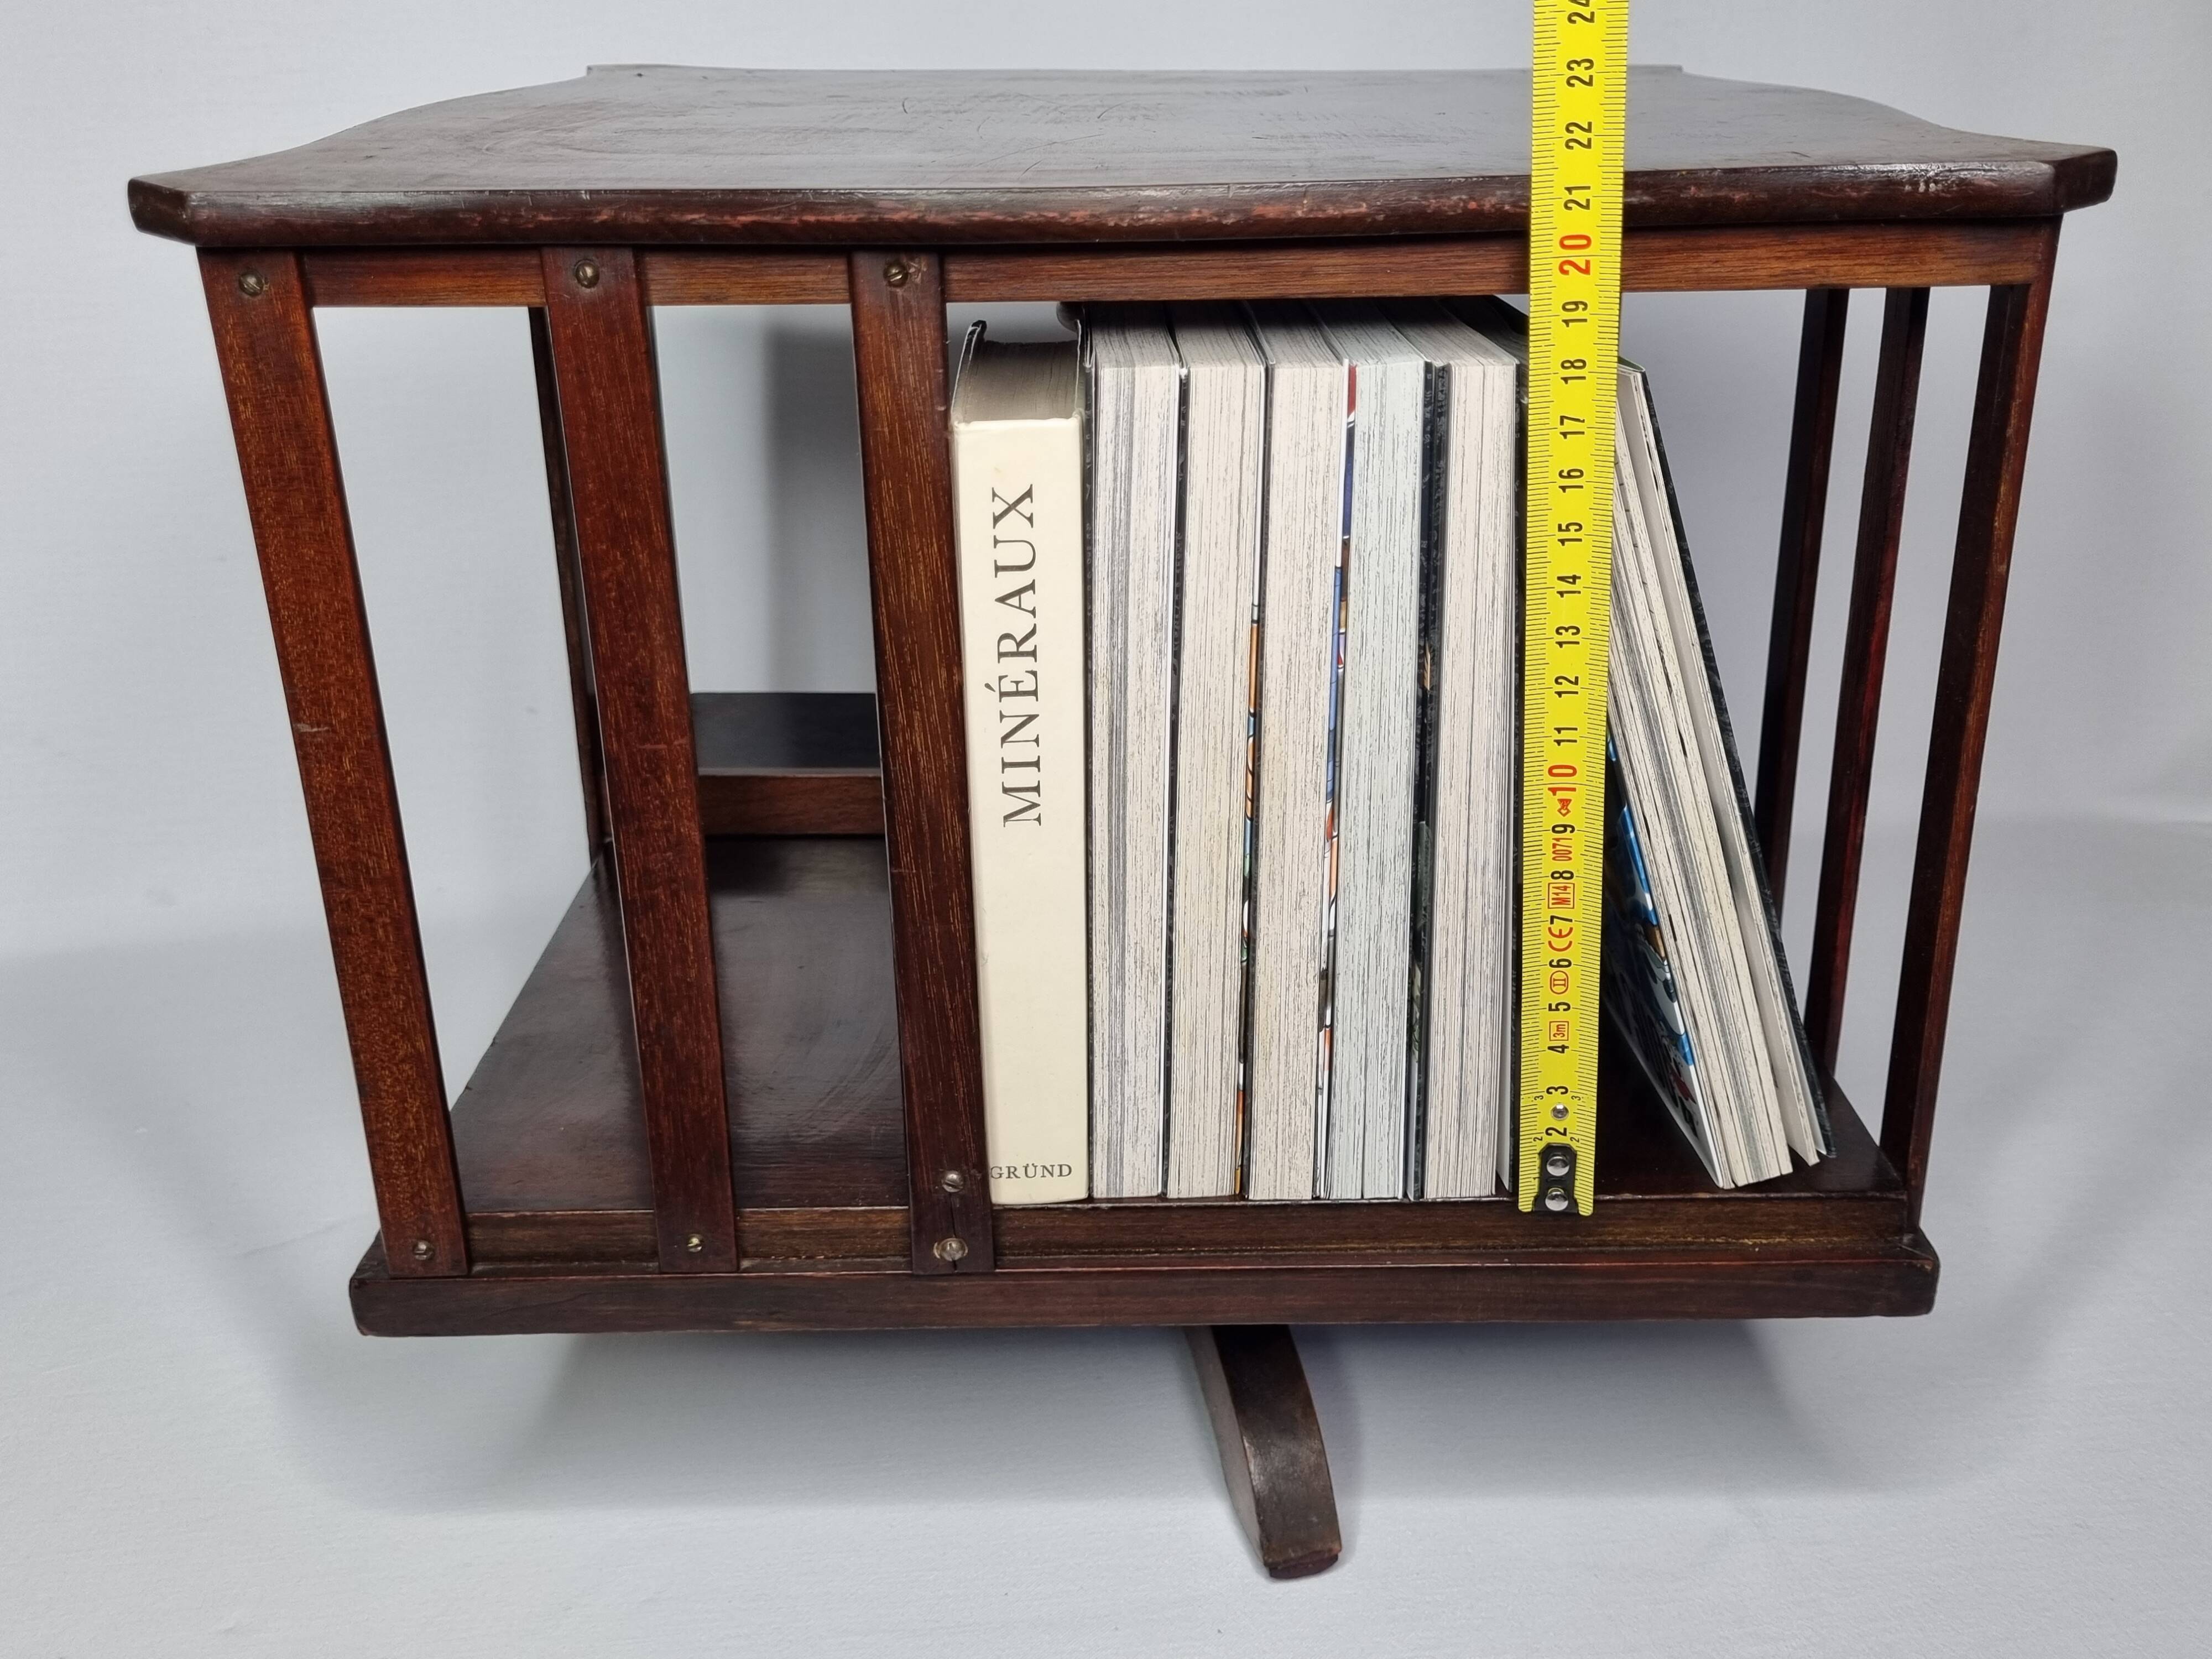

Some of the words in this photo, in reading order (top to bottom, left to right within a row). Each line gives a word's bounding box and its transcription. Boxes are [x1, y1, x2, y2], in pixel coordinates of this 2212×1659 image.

[1566, 58, 1594, 87] 23
[1564, 121, 1592, 150] 22
[1563, 186, 1591, 211] 21
[1558, 234, 1592, 275] 20
[1561, 300, 1588, 327] 19
[1560, 358, 1587, 384] 18
[1559, 415, 1585, 439] 17
[1558, 468, 1584, 493] 16
[1557, 522, 1583, 546] 15
[1556, 575, 1581, 598] 14
[1555, 625, 1580, 648] 13
[984, 484, 1041, 827] MINÉRAUX
[1554, 676, 1579, 698] 12
[1553, 727, 1578, 746] 11
[1548, 764, 1577, 796] 10
[1551, 824, 1575, 834] 9
[1551, 870, 1574, 880] 8
[1550, 915, 1573, 925] 7
[1549, 958, 1572, 968] 6
[1548, 1001, 1571, 1011] 5
[1547, 1044, 1569, 1054] 4
[1546, 1086, 1568, 1095] 3
[1545, 1127, 1567, 1136] 2
[990, 1163, 1072, 1179] GRÜND
